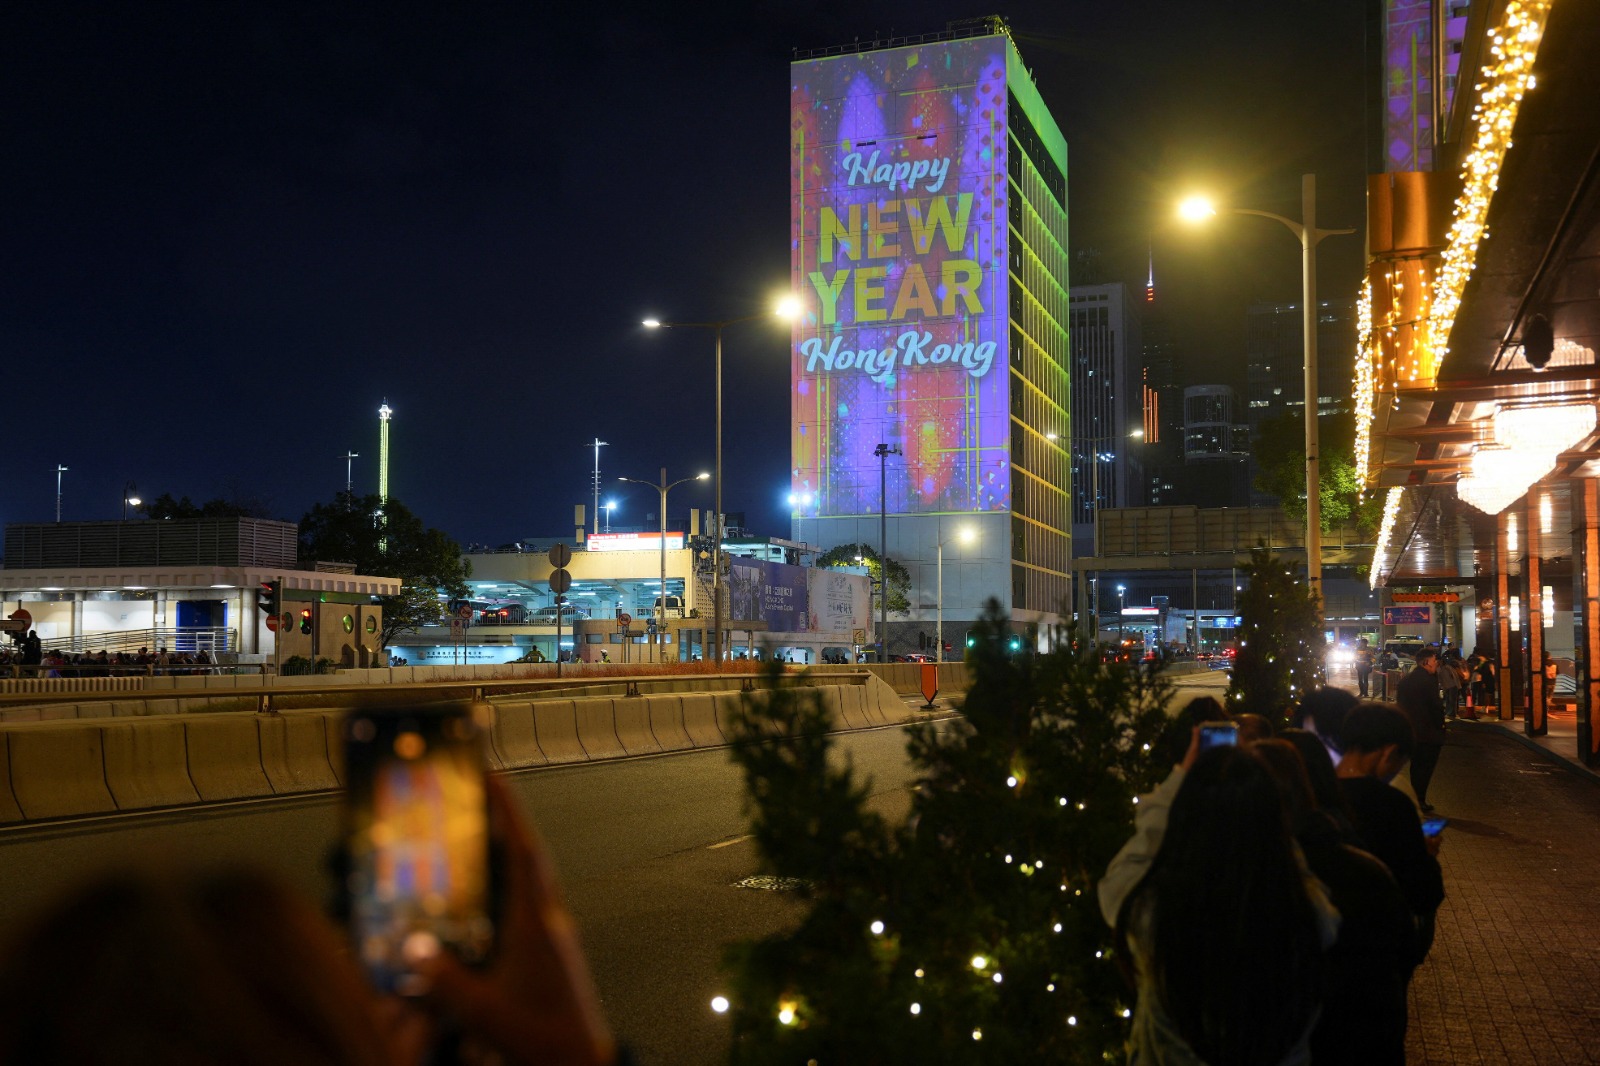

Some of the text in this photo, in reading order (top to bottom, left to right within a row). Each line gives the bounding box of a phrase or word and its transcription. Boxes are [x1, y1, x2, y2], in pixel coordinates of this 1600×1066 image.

[842, 150, 950, 193] Happy
[820, 192, 974, 263] NEW
[808, 259, 985, 326] YEAR
